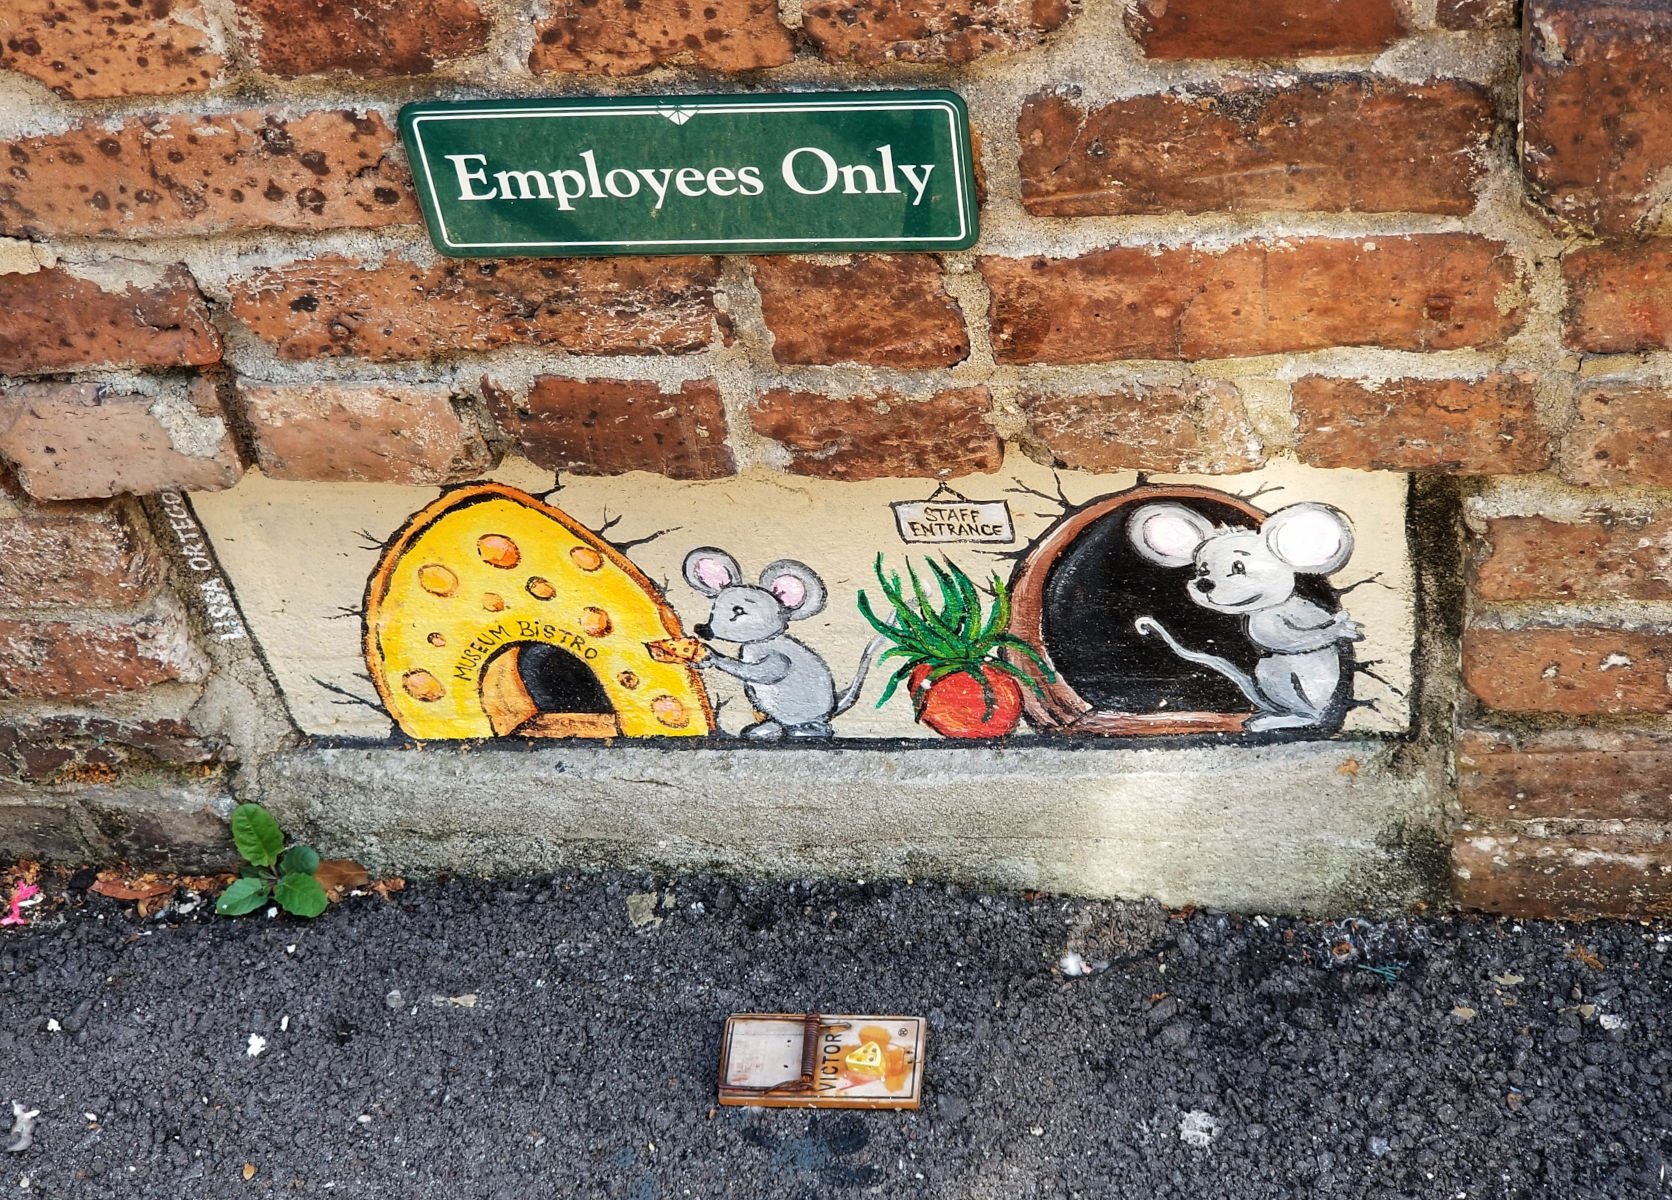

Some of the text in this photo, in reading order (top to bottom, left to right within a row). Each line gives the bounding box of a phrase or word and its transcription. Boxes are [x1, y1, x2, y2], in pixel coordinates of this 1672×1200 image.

[444, 145, 936, 211] Employees Only
[907, 521, 1003, 537] ENTRANCE
[924, 506, 979, 523] STAFF
[454, 624, 512, 681] MUSEUM
[819, 1033, 843, 1092] VICTOR
